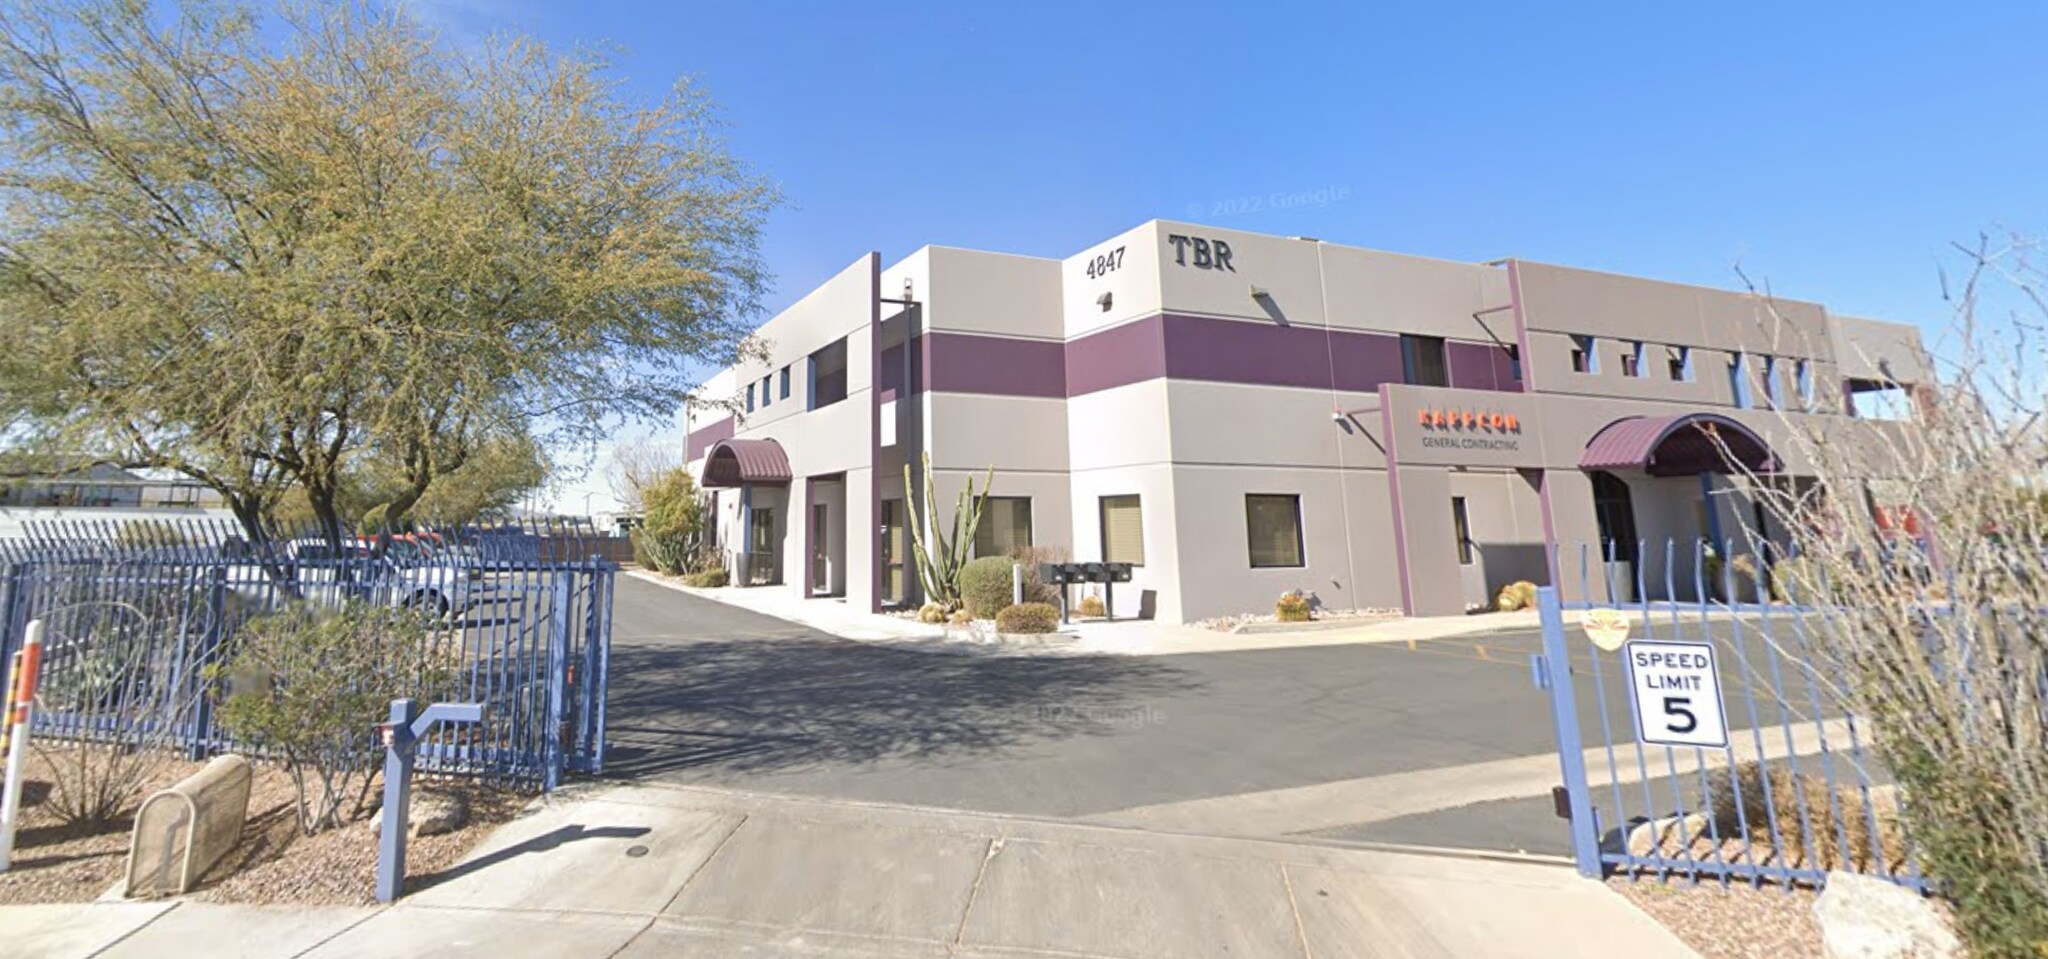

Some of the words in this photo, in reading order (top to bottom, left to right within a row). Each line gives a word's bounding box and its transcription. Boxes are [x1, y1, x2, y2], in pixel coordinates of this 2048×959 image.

[1086, 246, 1126, 279] 4847
[1168, 234, 1236, 273] TBR
[1419, 408, 1520, 433] KAPPCON
[1422, 437, 1460, 449] GENERAL
[1461, 438, 1519, 452] CONTRACTING
[1636, 652, 1708, 669] SPEED
[1646, 674, 1701, 690] LIMIT
[1663, 697, 1697, 733] 5
